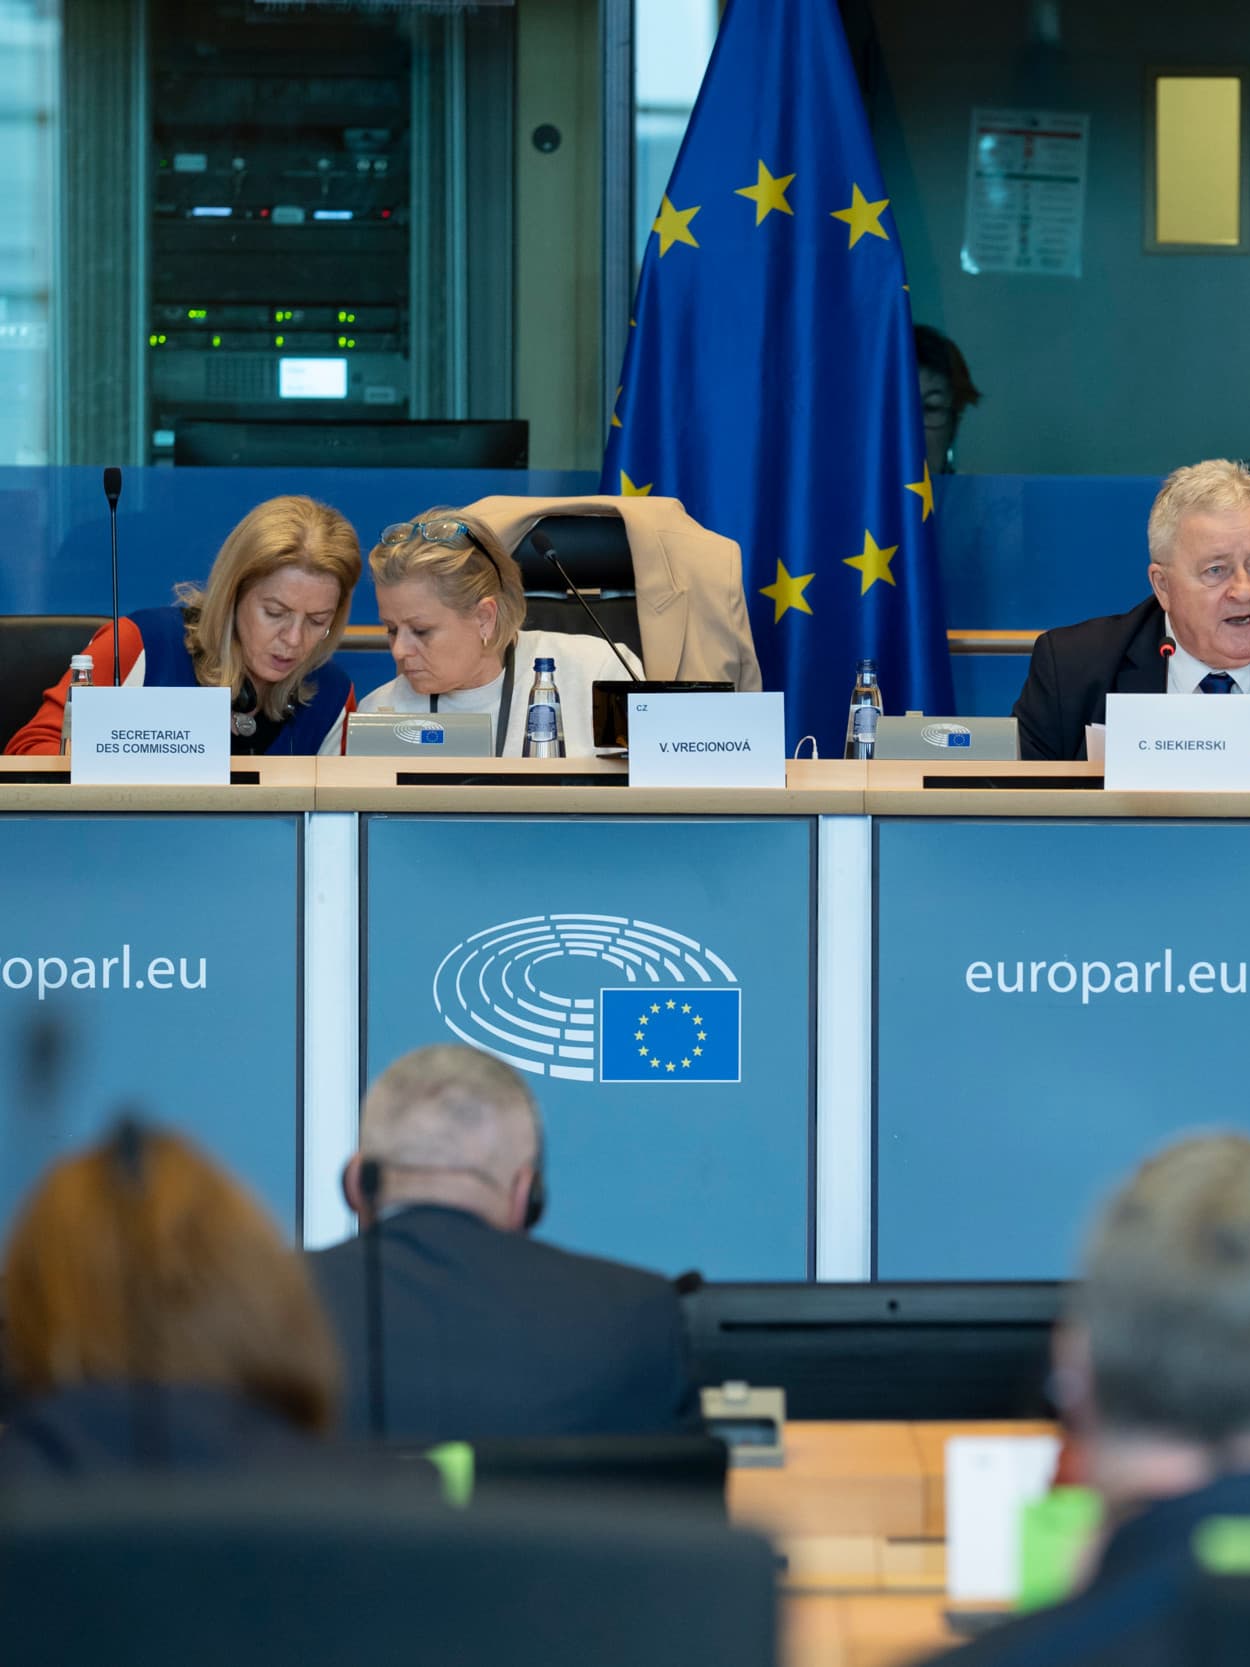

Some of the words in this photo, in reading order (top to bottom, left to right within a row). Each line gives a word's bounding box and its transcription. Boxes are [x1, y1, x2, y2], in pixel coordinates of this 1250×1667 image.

[636, 704, 649, 712] CZ
[111, 729, 191, 740] SECRETARIAT
[96, 743, 120, 754] DES
[122, 743, 206, 754] COMMISSIONS
[659, 742, 670, 753] V.
[672, 738, 752, 753] VRECIONOVÁ
[1138, 740, 1151, 751] C.
[1154, 740, 1226, 751] SIEKIERSKI
[0, 943, 207, 1001] oparl.eu
[965, 948, 1248, 1005] europarl.eu
